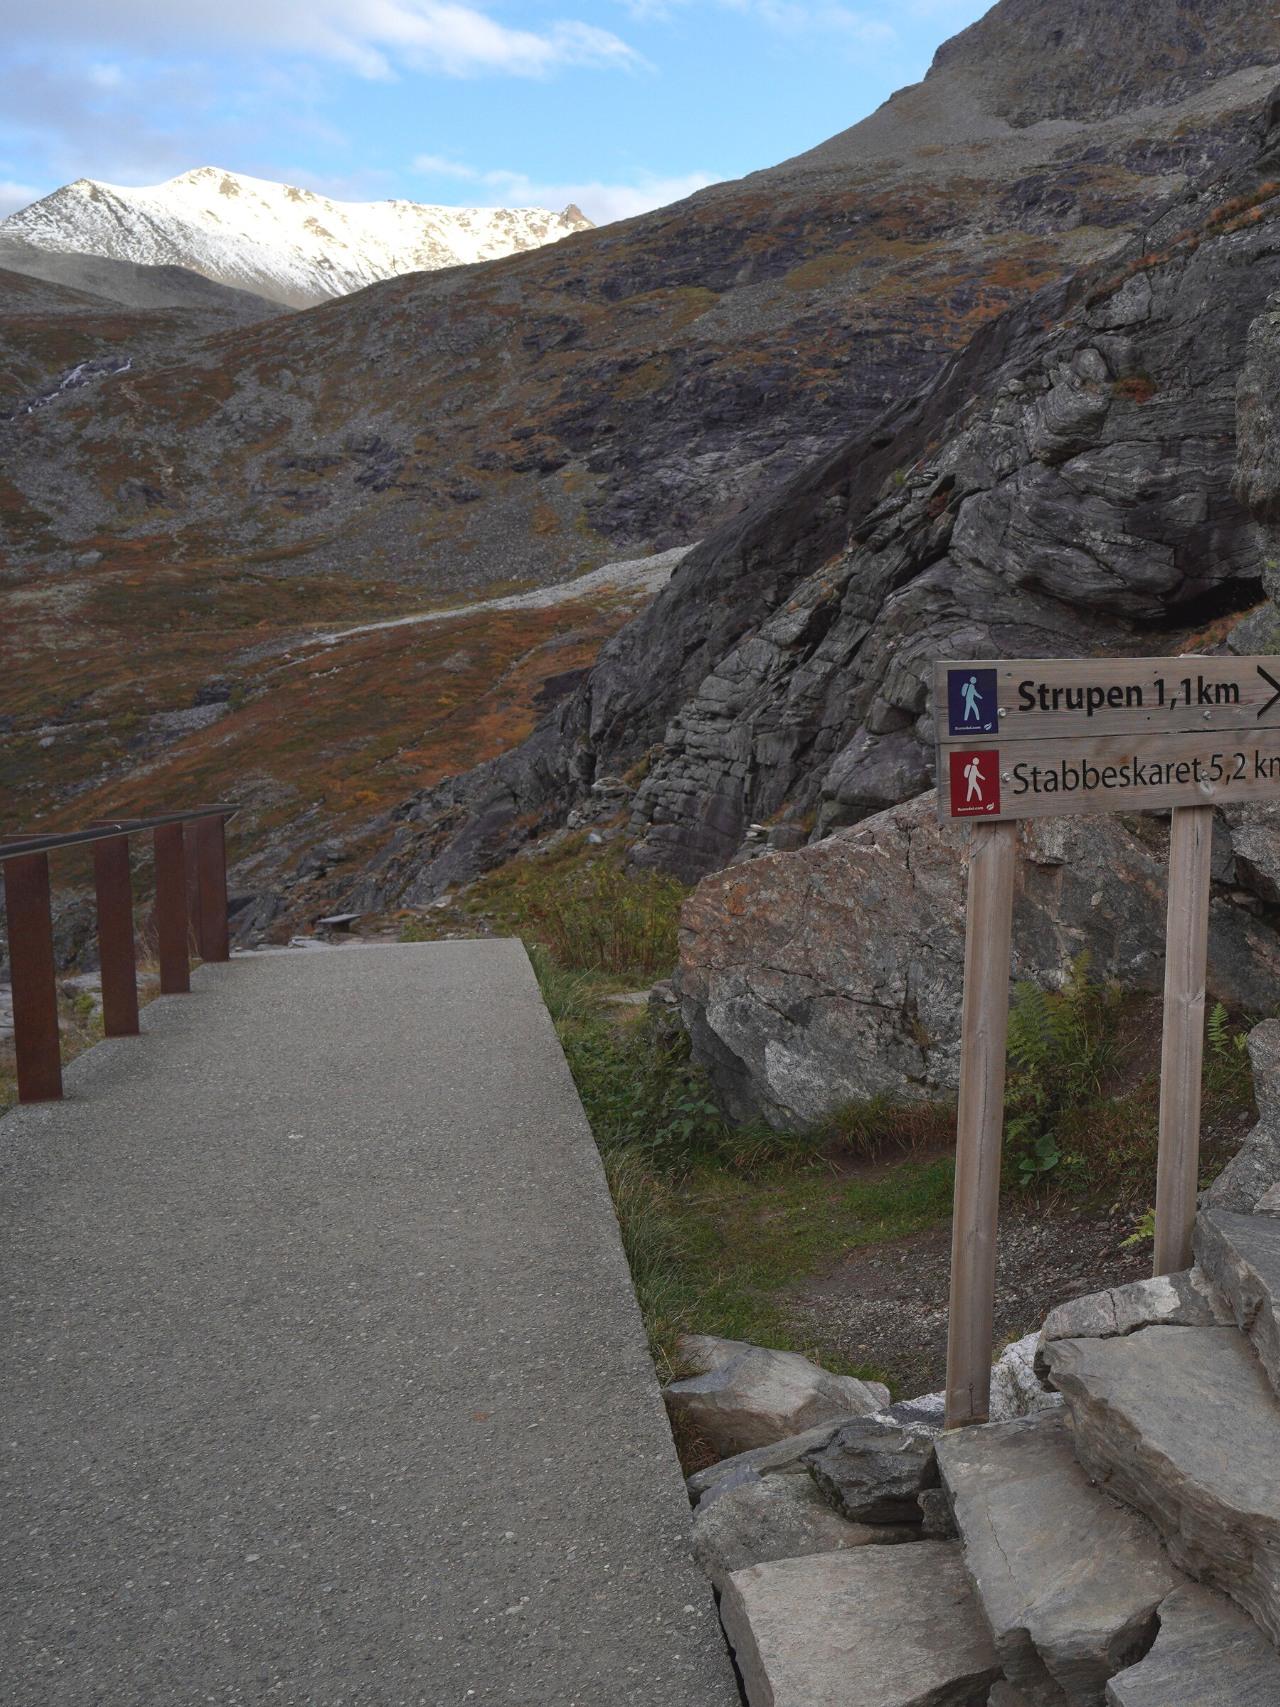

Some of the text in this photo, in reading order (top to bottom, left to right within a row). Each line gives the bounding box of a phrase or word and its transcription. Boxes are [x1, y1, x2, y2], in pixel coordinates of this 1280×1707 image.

[1018, 680, 1143, 717] Strupen
[1013, 756, 1202, 795] Stabbeskaret
[1209, 752, 1247, 785] 5,2
